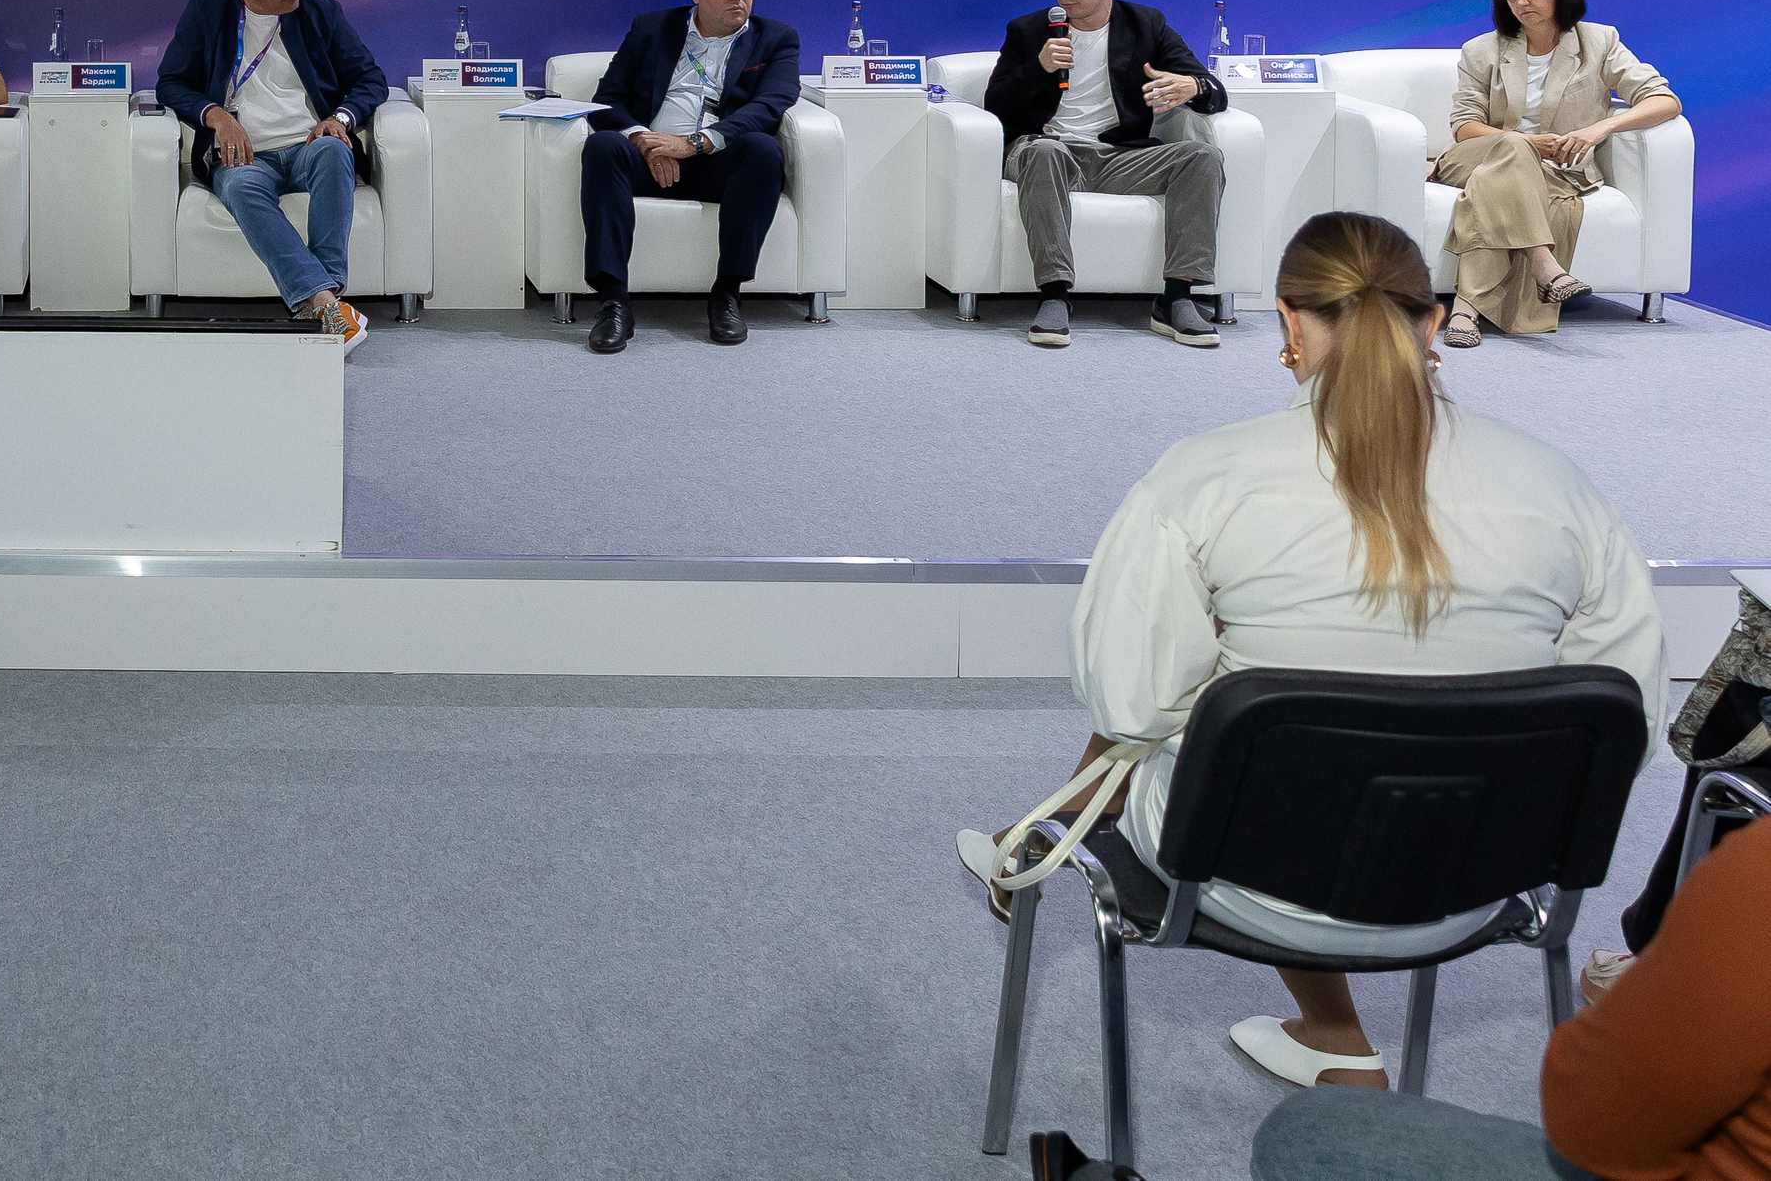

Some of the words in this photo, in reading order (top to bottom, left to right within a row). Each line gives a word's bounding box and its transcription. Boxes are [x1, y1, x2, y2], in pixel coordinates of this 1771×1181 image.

[465, 65, 514, 74] Владислав
[868, 62, 916, 71] Владимир
[1270, 60, 1305, 70] Окна
[81, 67, 116, 76] Максим
[1264, 71, 1314, 80] Полянская
[473, 75, 506, 84] Волгин
[870, 72, 916, 81] Гримайло
[82, 78, 116, 87] Бардин
